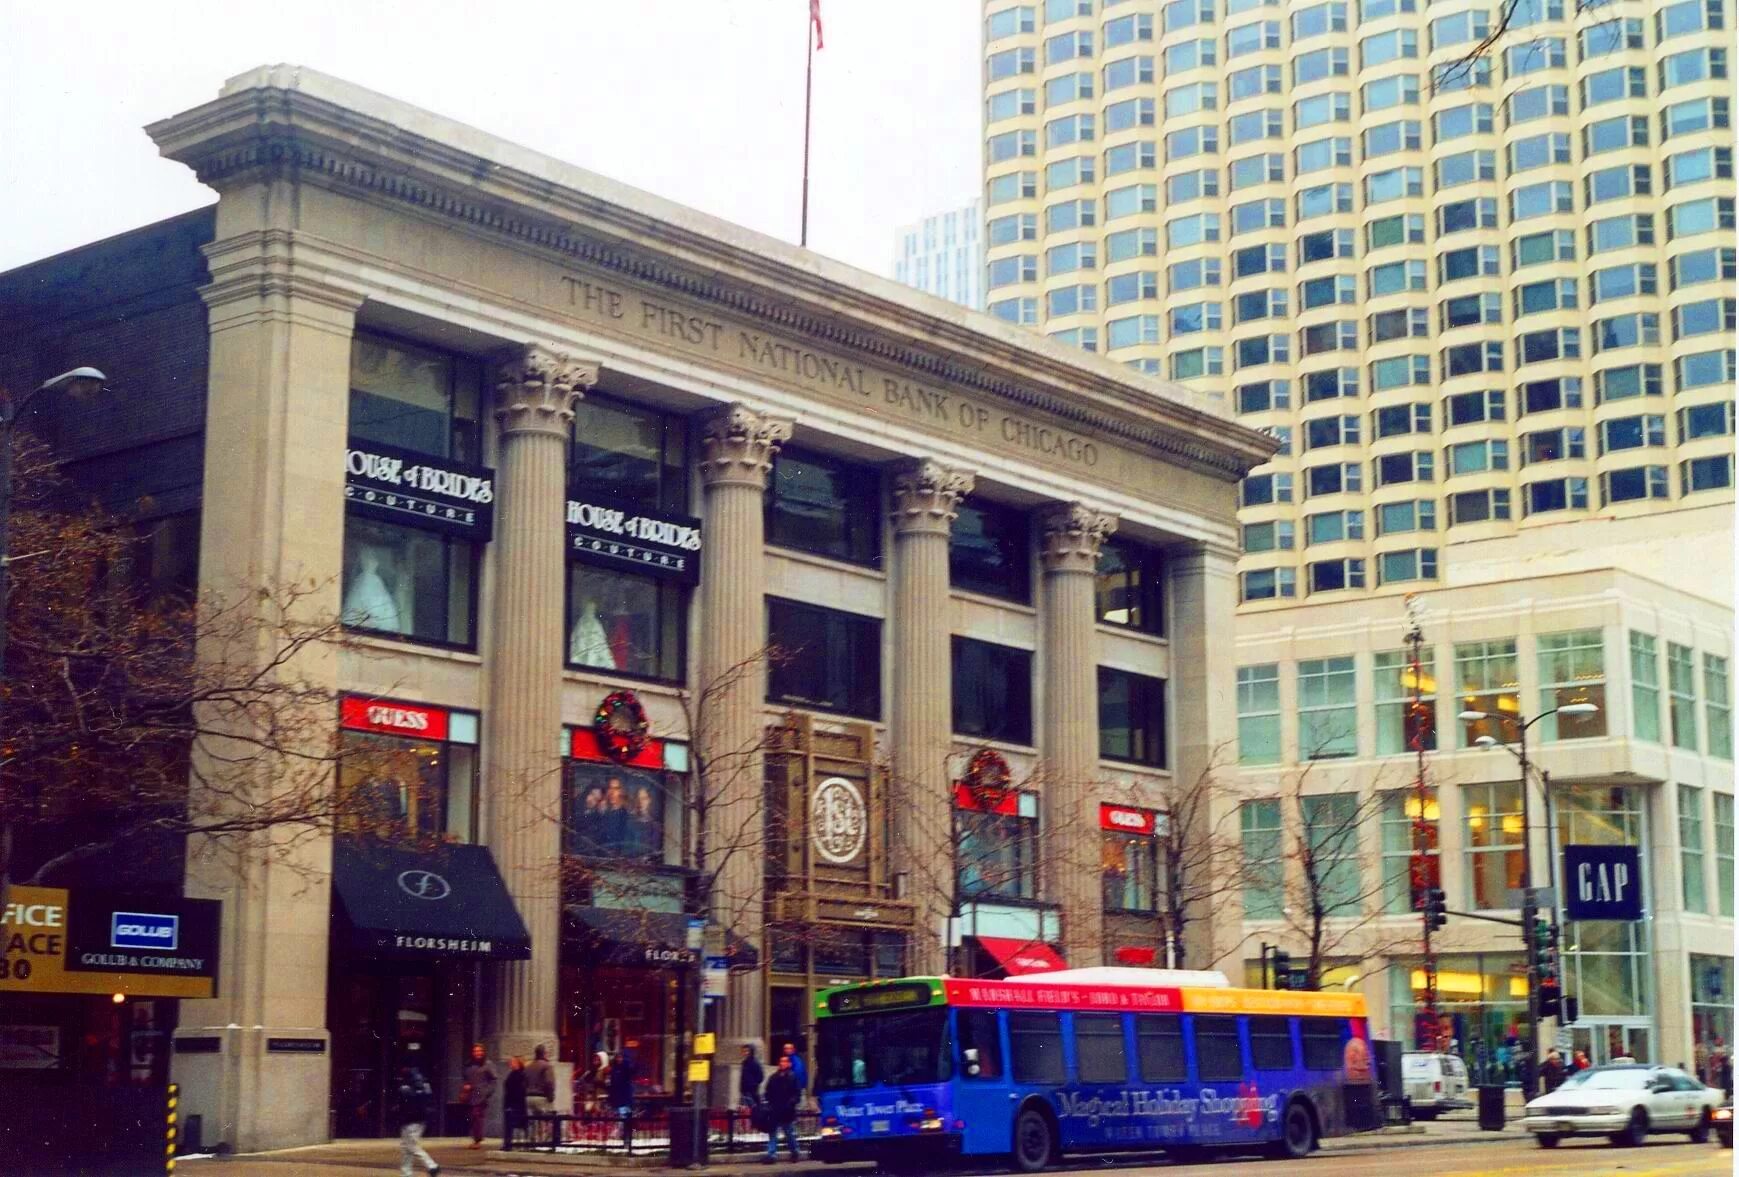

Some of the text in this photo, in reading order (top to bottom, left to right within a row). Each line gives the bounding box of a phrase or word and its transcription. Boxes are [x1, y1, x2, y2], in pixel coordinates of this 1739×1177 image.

[561, 276, 1099, 467] THE FIRST NATIONAL BANK OF CHICAGO
[420, 466, 493, 503] BRIDES
[567, 500, 624, 535] HOUSE
[639, 517, 701, 551] BRIDES
[367, 705, 428, 730] GUESS
[1578, 862, 1628, 903] GAP
[116, 924, 173, 938] GOLUB
[396, 936, 491, 953] FLORSHEIM
[81, 952, 127, 966] GOLUB
[140, 956, 205, 970] COMPANY
